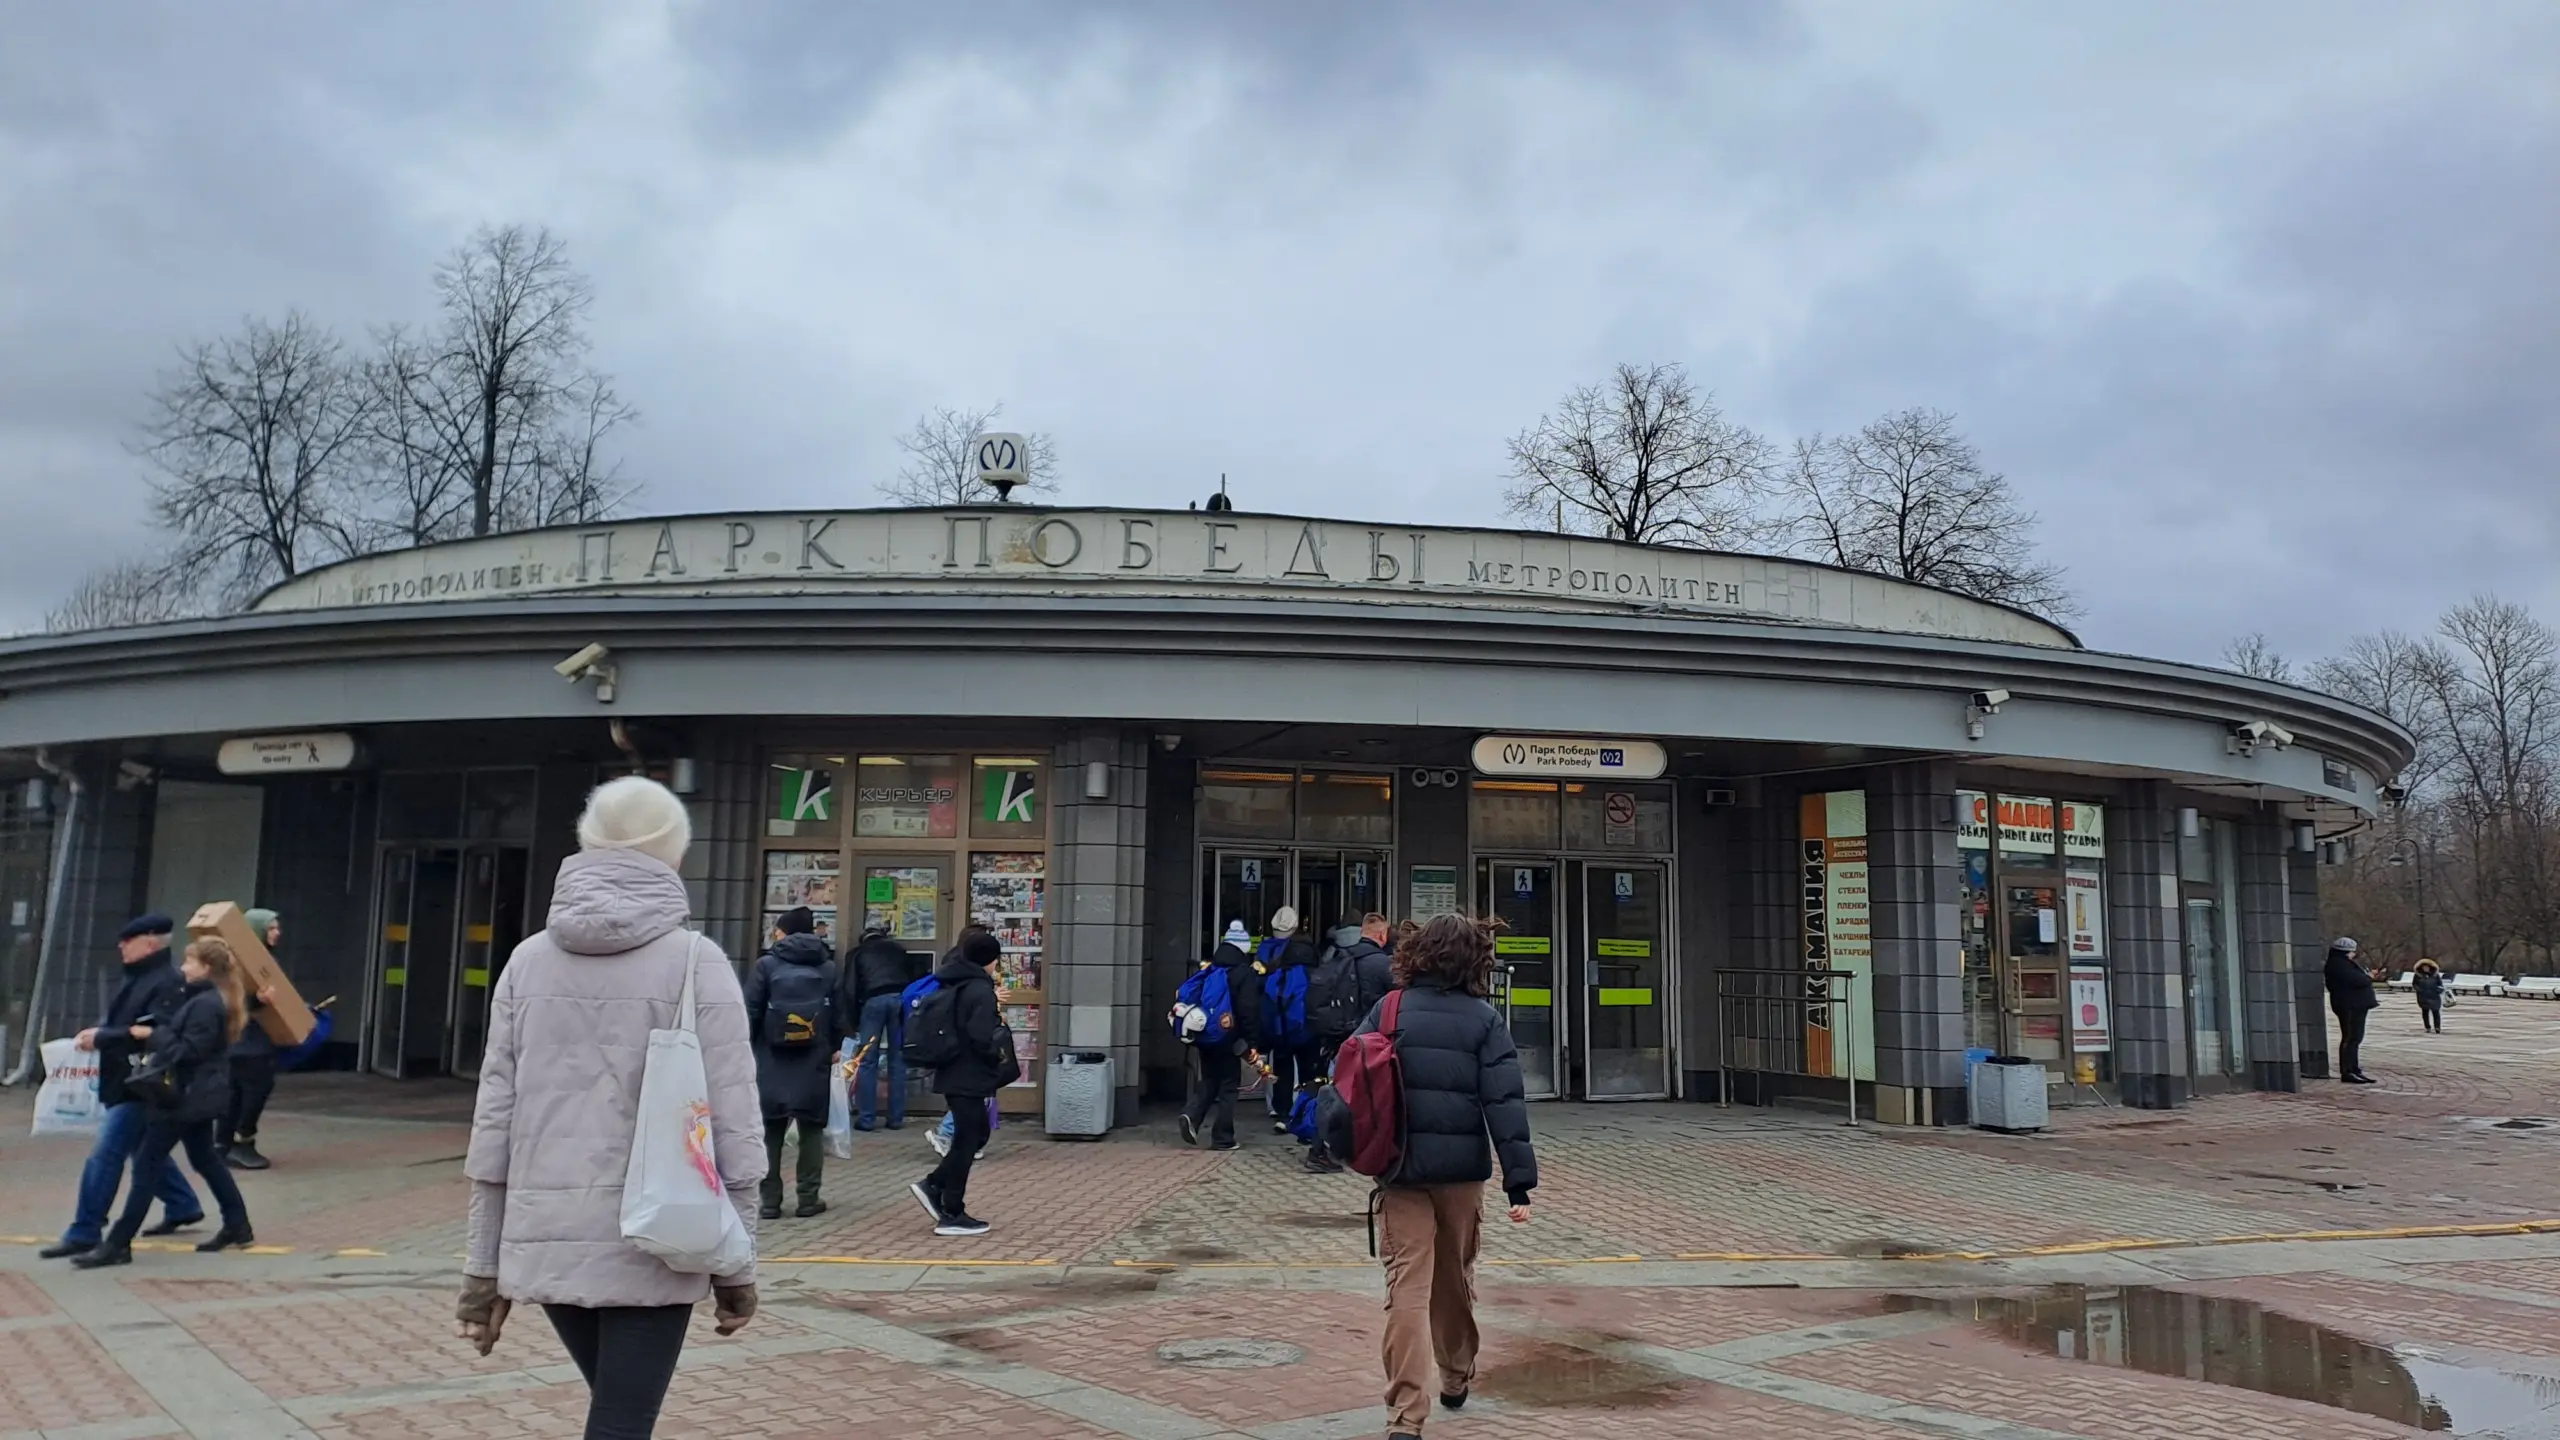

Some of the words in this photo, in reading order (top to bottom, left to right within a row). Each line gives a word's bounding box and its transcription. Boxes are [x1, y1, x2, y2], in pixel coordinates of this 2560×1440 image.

[575, 518, 845, 583] ПАРК
[942, 516, 1427, 584] ПОБЕДЫ
[1467, 560, 1741, 605] МЕТРОПОЛИТЕН
[1530, 745, 1555, 757] Парк
[1558, 745, 1599, 758] Победы
[1537, 757, 1557, 766] Park
[1559, 758, 1592, 768] Pobedy
[860, 787, 954, 804] КУРЬЕР
[1837, 887, 1867, 895] СТЕКЛА
